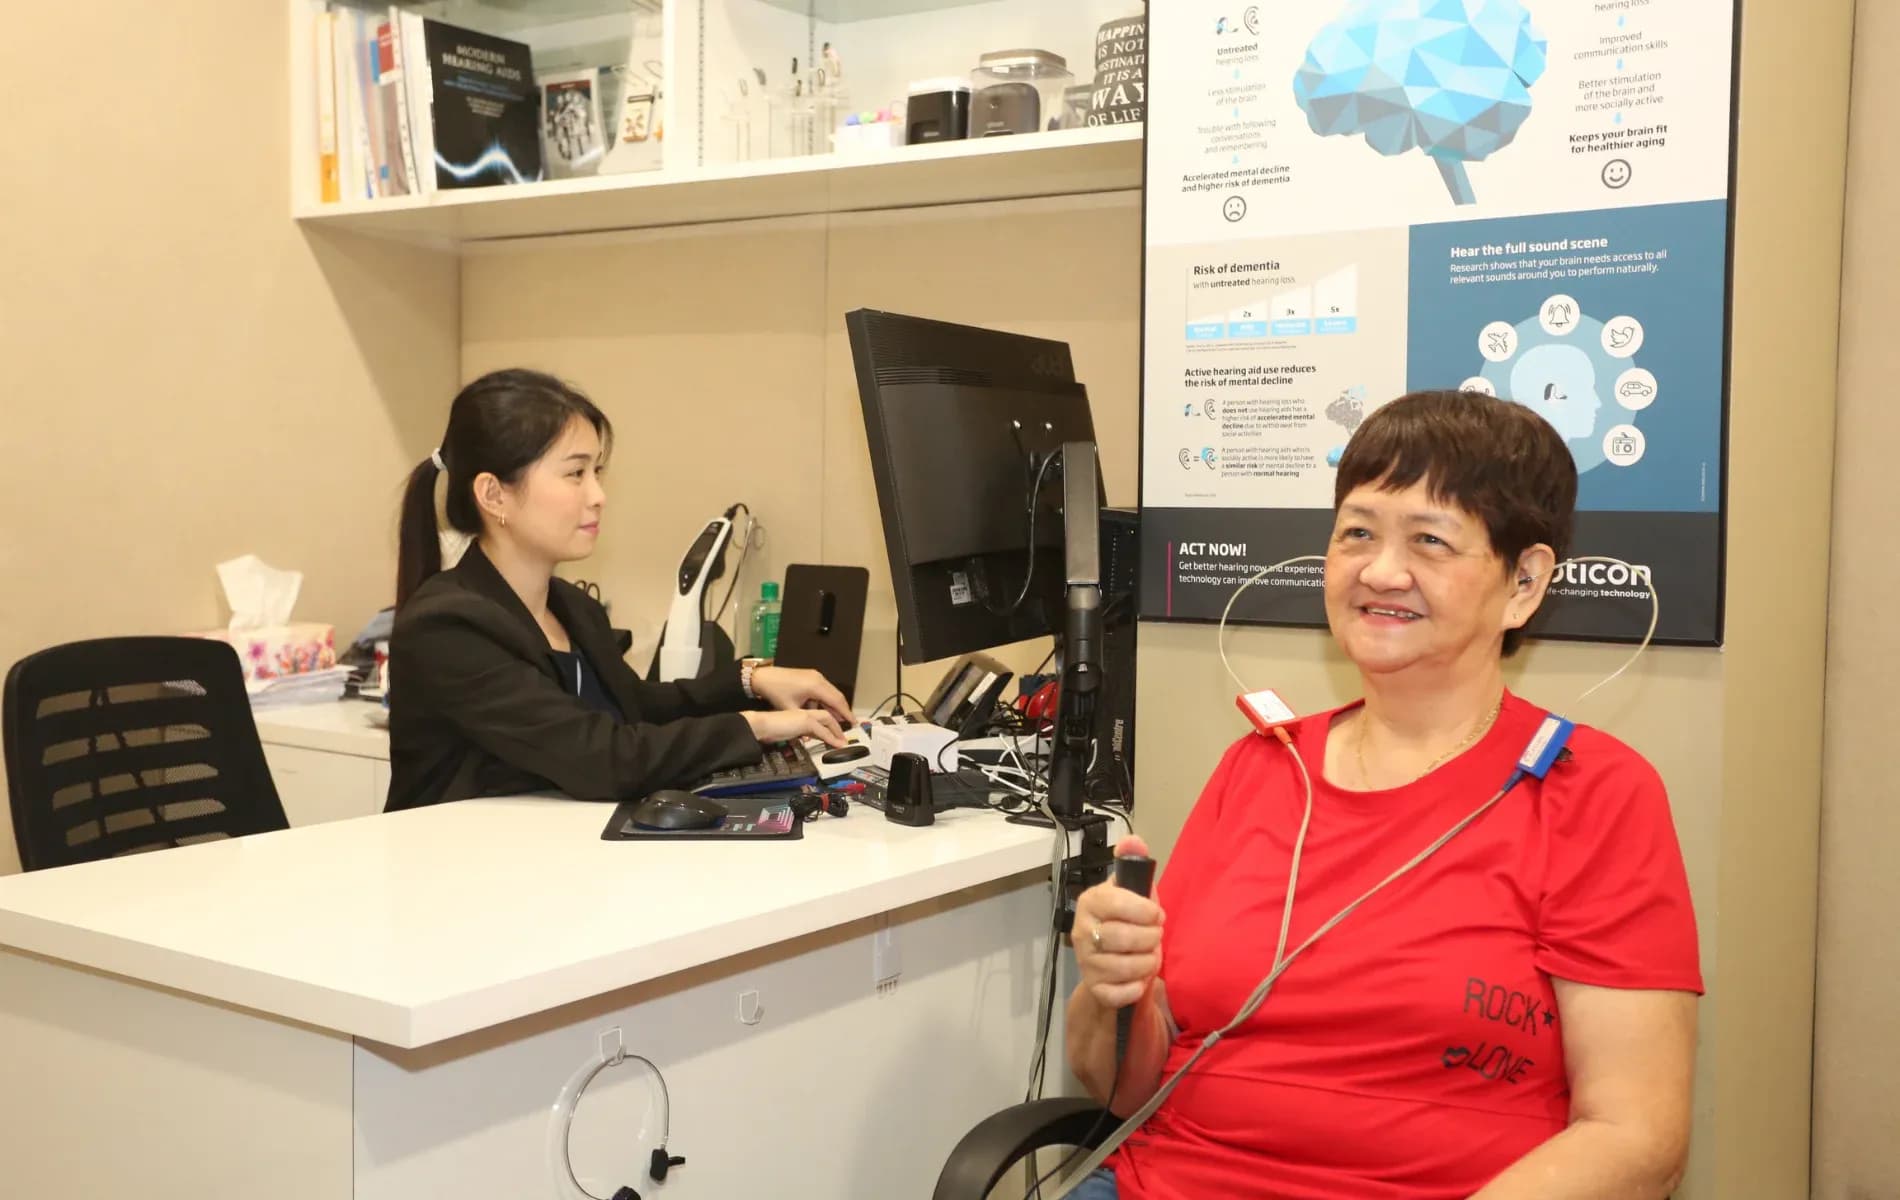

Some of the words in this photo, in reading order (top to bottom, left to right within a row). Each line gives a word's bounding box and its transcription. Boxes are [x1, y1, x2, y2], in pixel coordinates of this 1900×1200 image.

[1594, 1, 1629, 12] hearing
[1098, 24, 1145, 45] HAPPIN
[1600, 31, 1642, 45] Improved
[1217, 43, 1258, 55] Untreated
[1574, 44, 1643, 60] communication
[1645, 40, 1668, 49] skills
[1104, 72, 1116, 85] IT
[1117, 70, 1130, 80] IS
[1578, 79, 1607, 89] Better
[1609, 72, 1662, 85] stimulation
[1092, 82, 1144, 110] WAY
[1584, 91, 1593, 101] of
[1595, 89, 1611, 98] the
[1612, 86, 1636, 97] brain
[1637, 83, 1655, 94] and
[1575, 102, 1598, 112] more
[1600, 97, 1634, 110] socially
[1635, 95, 1664, 106] active
[1088, 113, 1107, 128] OF
[1111, 108, 1144, 123] LIF
[1569, 133, 1600, 143] Keeps
[1602, 130, 1624, 141] your
[1627, 126, 1653, 137] brain
[1656, 124, 1668, 133] fit
[1571, 145, 1585, 154] for
[1587, 140, 1633, 152] healthier
[1636, 136, 1665, 148] aging
[1183, 171, 1229, 182] Accelerated
[1230, 167, 1258, 178] mental
[1260, 165, 1290, 175] decline
[1182, 183, 1196, 192] and
[1198, 181, 1223, 192] higher
[1225, 179, 1240, 188] risk
[1242, 178, 1250, 186] of
[1251, 175, 1290, 186] dementia
[1450, 246, 1480, 258] Hear
[1482, 244, 1503, 256] the
[1505, 242, 1526, 254] full
[1529, 239, 1568, 252] sound
[1570, 237, 1608, 249] scene
[1193, 265, 1215, 276] Risk
[1217, 264, 1228, 274] of
[1230, 260, 1280, 273] dementia
[1450, 258, 1489, 273] Research
[1490, 258, 1517, 271] shows
[1519, 257, 1537, 268] that
[1538, 256, 1559, 269] your
[1559, 254, 1582, 266] brain
[1583, 252, 1611, 265] needs
[1612, 253, 1643, 263] access
[1645, 251, 1654, 260] to
[1656, 249, 1667, 259] all
[1450, 272, 1485, 284] relevant
[1486, 270, 1516, 282] sounds
[1517, 269, 1548, 280] around
[1549, 269, 1566, 279] you
[1567, 268, 1577, 277] to
[1578, 265, 1615, 278] perform
[1616, 262, 1659, 274] naturally.
[1193, 279, 1209, 288] with
[1210, 278, 1250, 288] untreated
[1251, 276, 1279, 286] hearing
[1280, 276, 1295, 284] loss
[1286, 308, 1295, 316] 3x
[1330, 305, 1340, 313] 5x
[1184, 368, 1212, 377] Active
[1213, 366, 1247, 377] hearing
[1248, 365, 1262, 375] aid
[1280, 364, 1317, 374] reduces
[1184, 379, 1199, 387] the
[1200, 378, 1216, 387] risk
[1218, 377, 1227, 386] of
[1228, 377, 1260, 386] mental
[1261, 375, 1293, 385] decline
[1179, 542, 1206, 555] ACT
[1209, 543, 1247, 556] NOW!
[1179, 561, 1192, 570] Get
[1193, 561, 1217, 571] better
[1219, 562, 1248, 573] hearing
[1284, 564, 1325, 574] experienc
[1179, 575, 1221, 586] technology
[1222, 577, 1237, 585] can
[1271, 578, 1326, 588] communicatio
[1600, 588, 1650, 599] technology
[1464, 976, 1541, 1036] ROCK
[1467, 1042, 1535, 1085] LOVE
